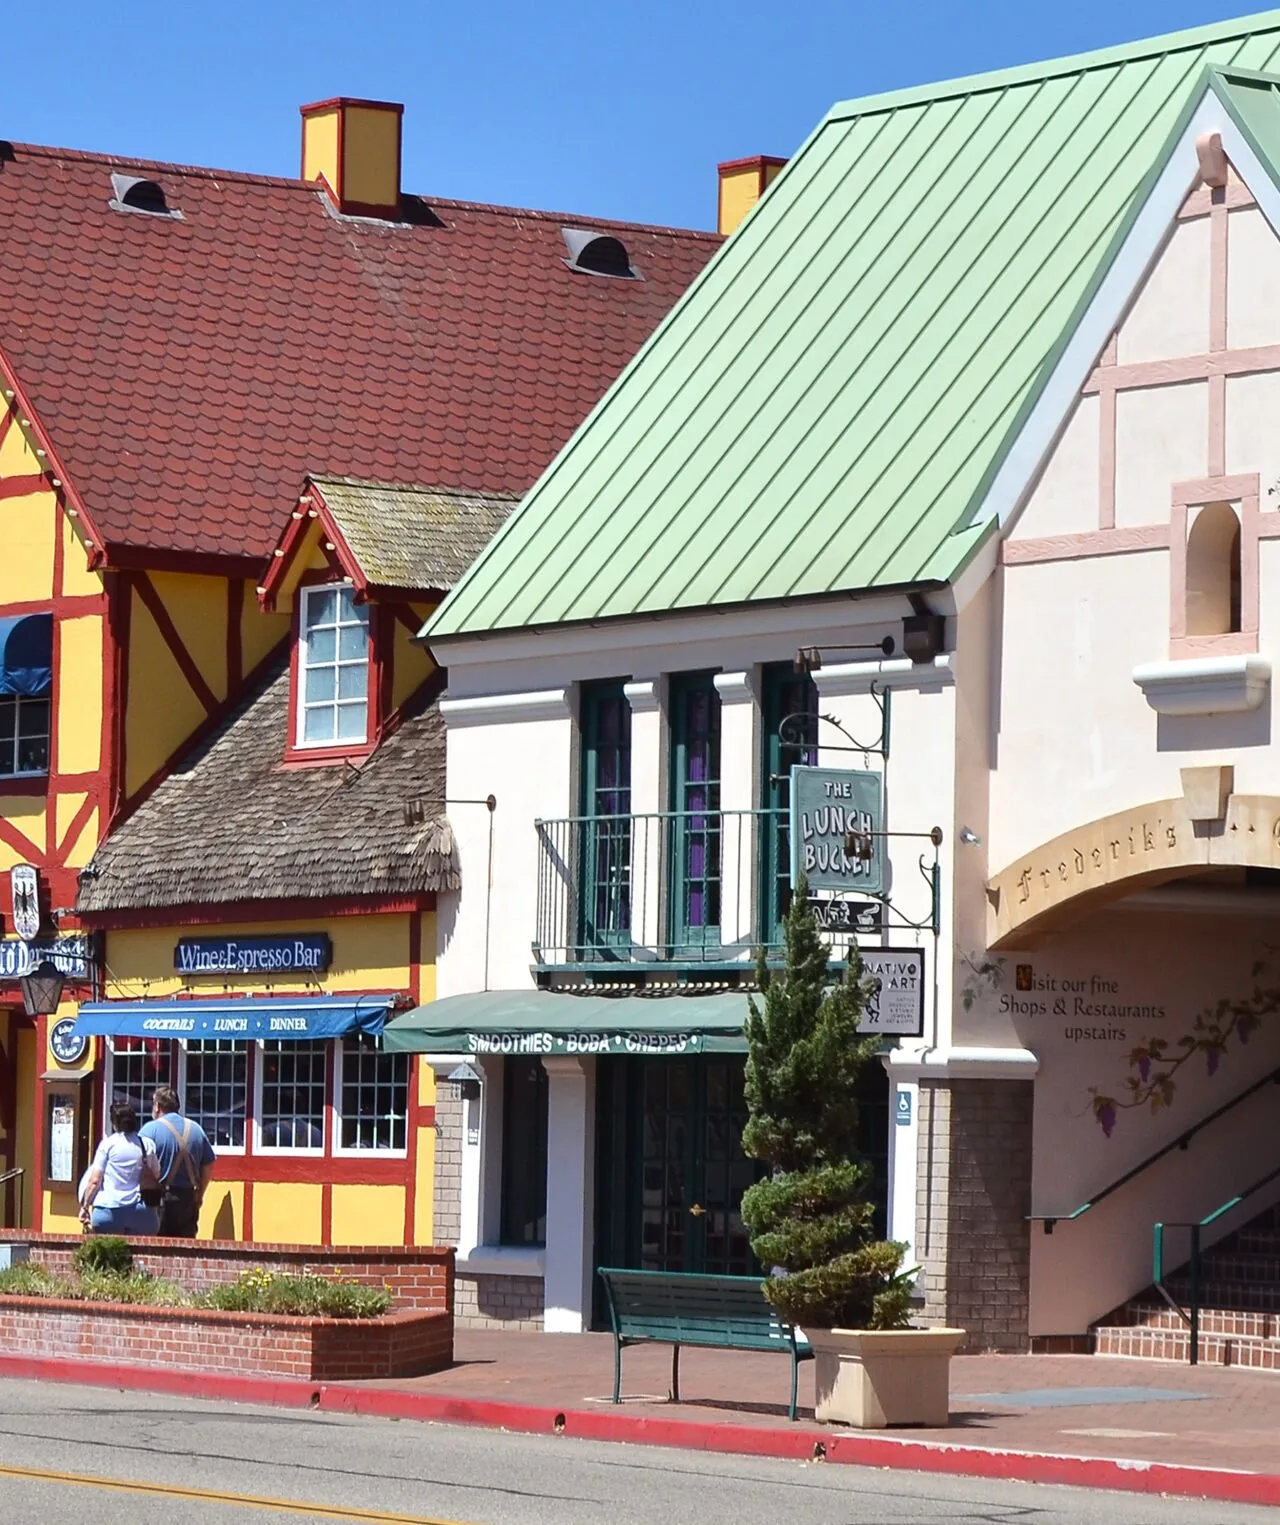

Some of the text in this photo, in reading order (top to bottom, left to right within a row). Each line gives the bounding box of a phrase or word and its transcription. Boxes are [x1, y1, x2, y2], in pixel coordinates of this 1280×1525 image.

[824, 782, 852, 798] THE
[802, 807, 872, 840] LUNCH
[1016, 818, 1177, 904] Frederik's
[17, 940, 85, 975] Deark
[294, 941, 321, 967] Bar
[865, 963, 917, 975] NATIVO
[890, 977, 917, 989] ART
[1061, 979, 1086, 993] our
[1090, 974, 1119, 996] fine
[998, 994, 1166, 1018] Shops & Restaurants
[142, 1017, 308, 1031] COCKTAILS LUNCH DINNER
[1064, 1023, 1127, 1046] upstairs
[468, 1032, 688, 1053] SMOOTHIES BOBA CREPES
